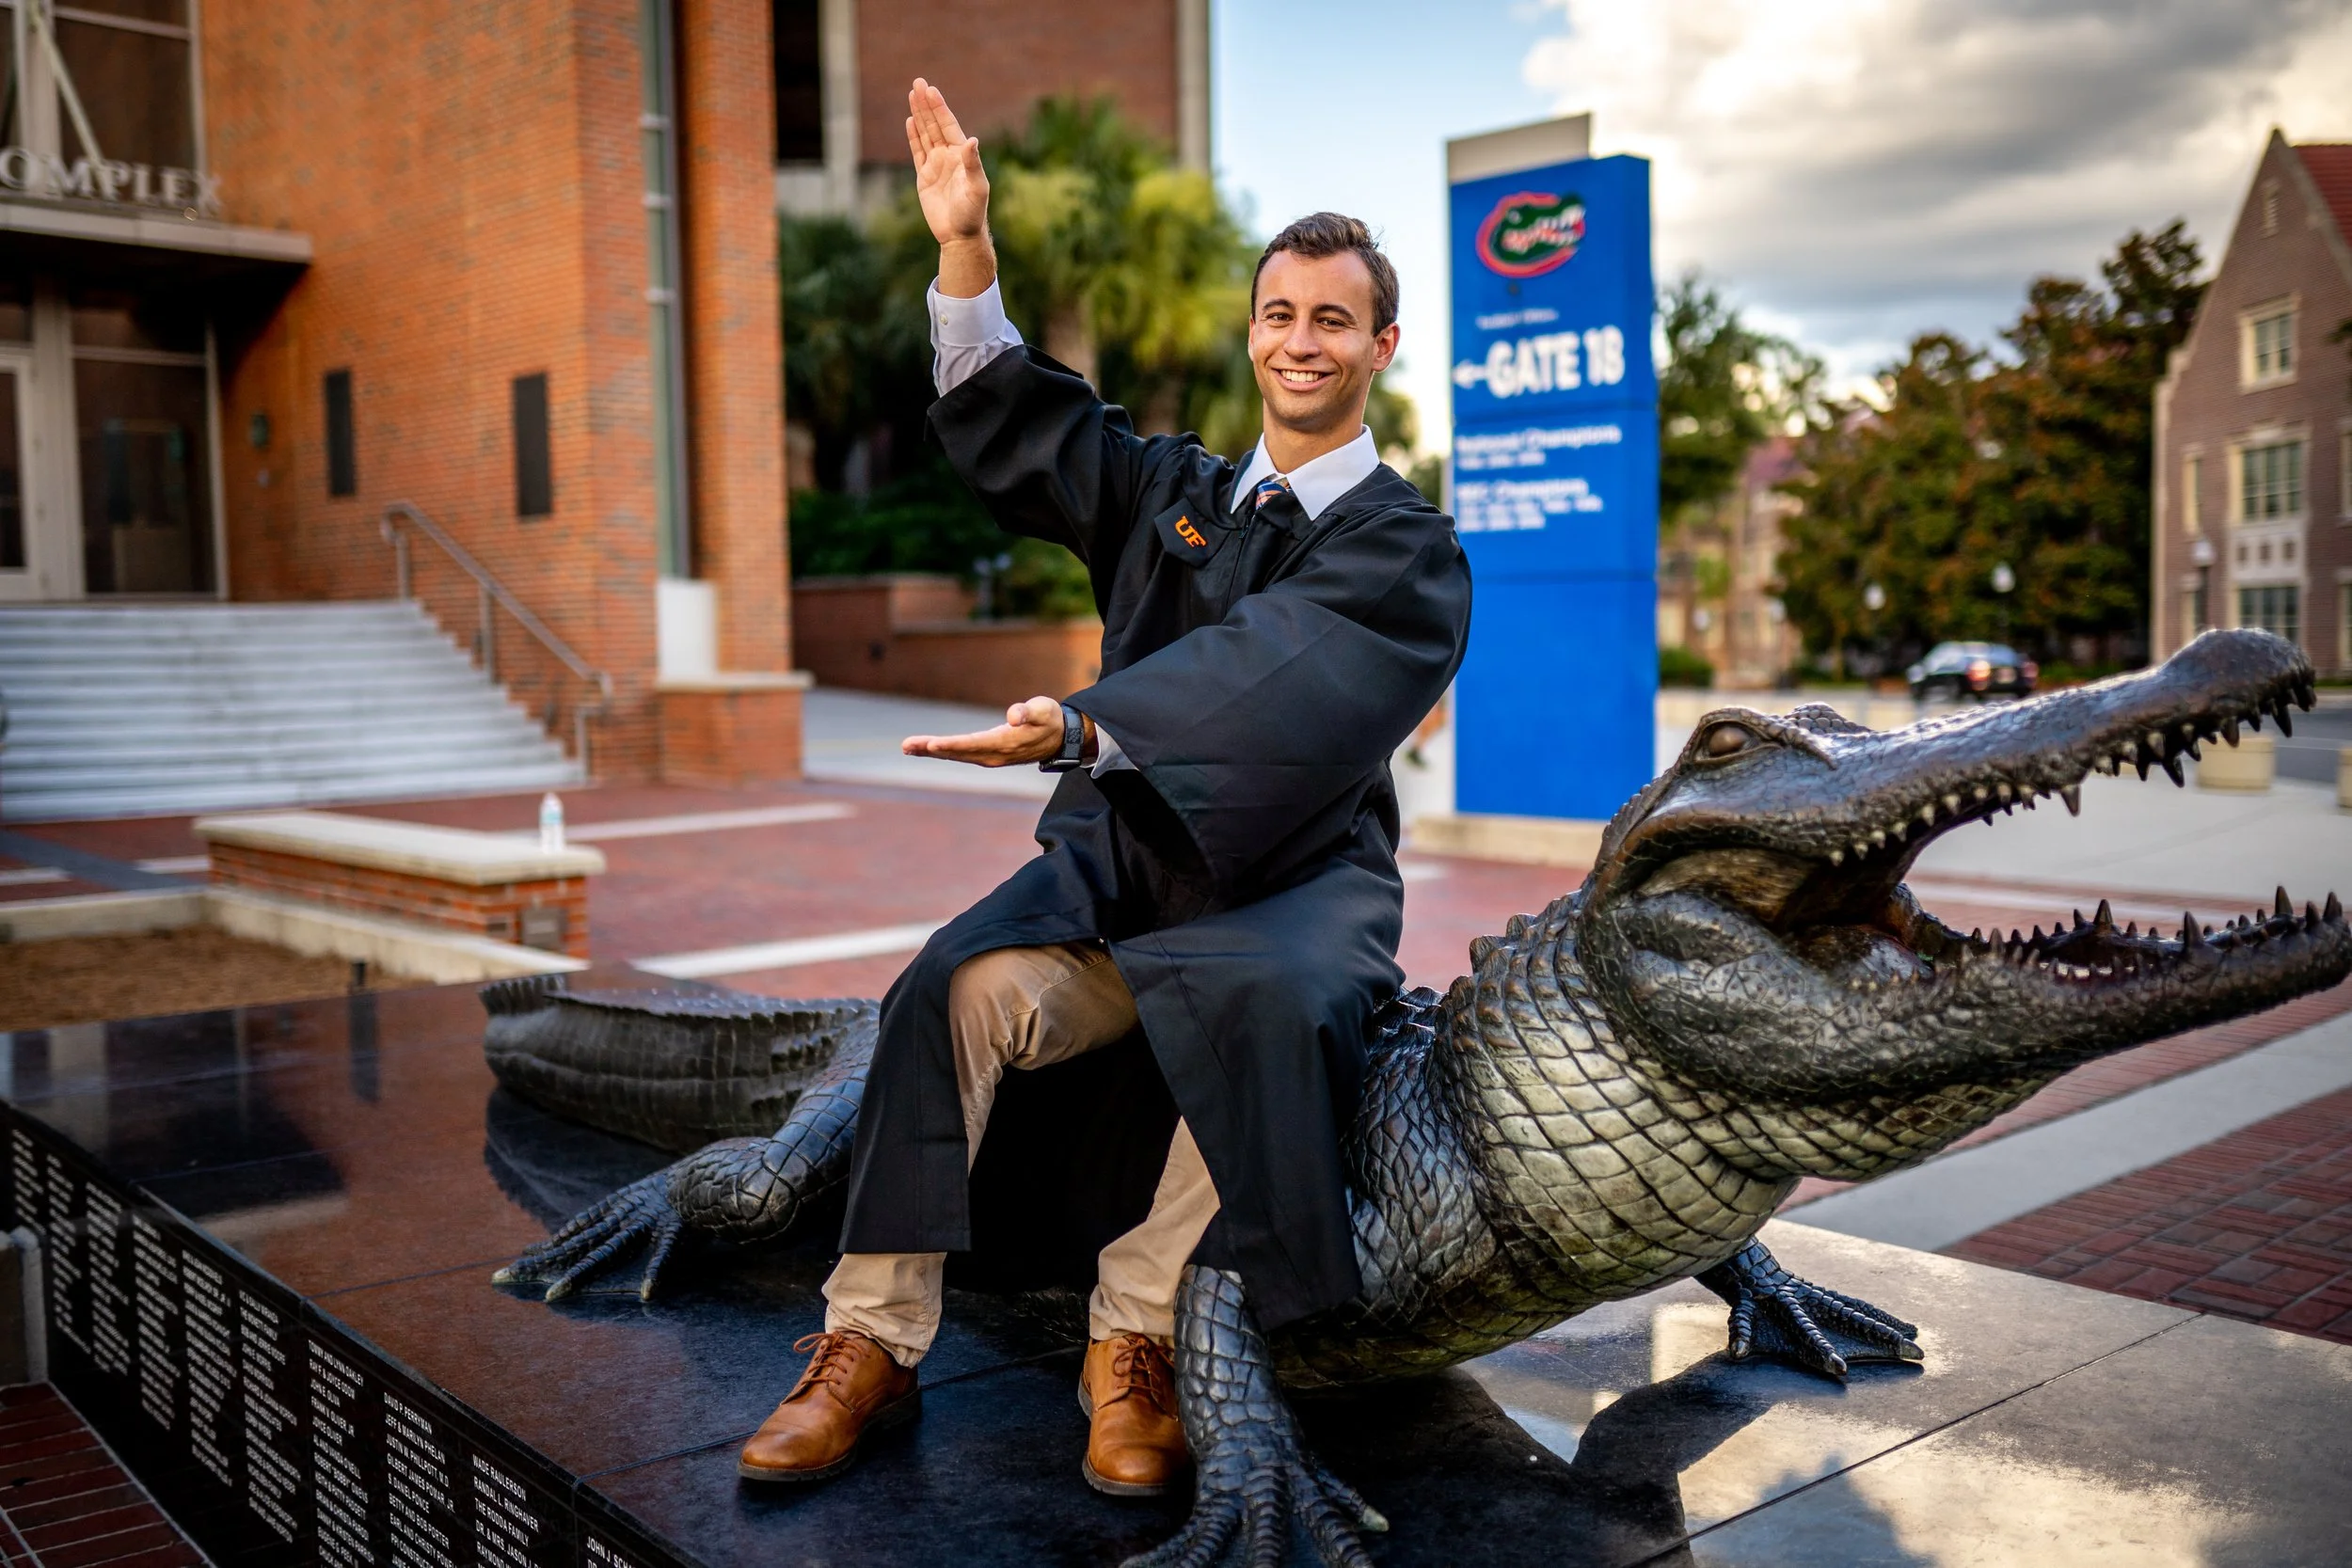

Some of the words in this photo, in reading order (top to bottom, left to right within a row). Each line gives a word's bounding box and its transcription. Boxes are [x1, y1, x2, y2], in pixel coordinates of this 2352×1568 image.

[1486, 331, 1581, 399] GATE
[1583, 325, 1626, 386] 18
[324, 1351, 333, 1367] AND
[333, 1356, 345, 1374] LYNN
[345, 1365, 364, 1386] OAKLEY
[326, 1370, 341, 1390] JOYCE
[311, 1396, 326, 1417] FRANK
[384, 1392, 398, 1413] DAVID
[405, 1405, 432, 1435] PERRYMAN
[312, 1415, 326, 1435] JOYCE
[326, 1425, 342, 1447] OLIVER
[385, 1413, 397, 1431] JEFF
[397, 1421, 402, 1434] &
[402, 1424, 423, 1449] MARILYN
[424, 1439, 445, 1465] PHELAN
[386, 1433, 403, 1455] JUSTIN
[387, 1452, 407, 1478] GILBERT
[408, 1467, 425, 1491] JAMES
[472, 1455, 489, 1477] WADE
[490, 1466, 526, 1502] RAULERSON
[393, 1476, 411, 1500] DANIEL
[412, 1490, 430, 1514] PONCE
[473, 1476, 497, 1503] RANDAL
[498, 1493, 503, 1508] L.
[504, 1497, 539, 1533] RINGHAVER
[389, 1493, 405, 1514] BETTY
[405, 1505, 416, 1524] AND
[416, 1514, 427, 1533] BOB
[428, 1523, 450, 1550] PORTER
[389, 1513, 403, 1532] EARL
[404, 1523, 414, 1543] AND
[415, 1532, 437, 1560] CHRISTY
[437, 1550, 457, 1568] POWE
[474, 1497, 486, 1517] THE
[486, 1506, 507, 1532] RODDA
[508, 1522, 529, 1548] FAMILY
[486, 1528, 491, 1542] &
[506, 1543, 527, 1568] JASON
[587, 1536, 605, 1560] JOHN
[613, 1553, 636, 1568] SCH
